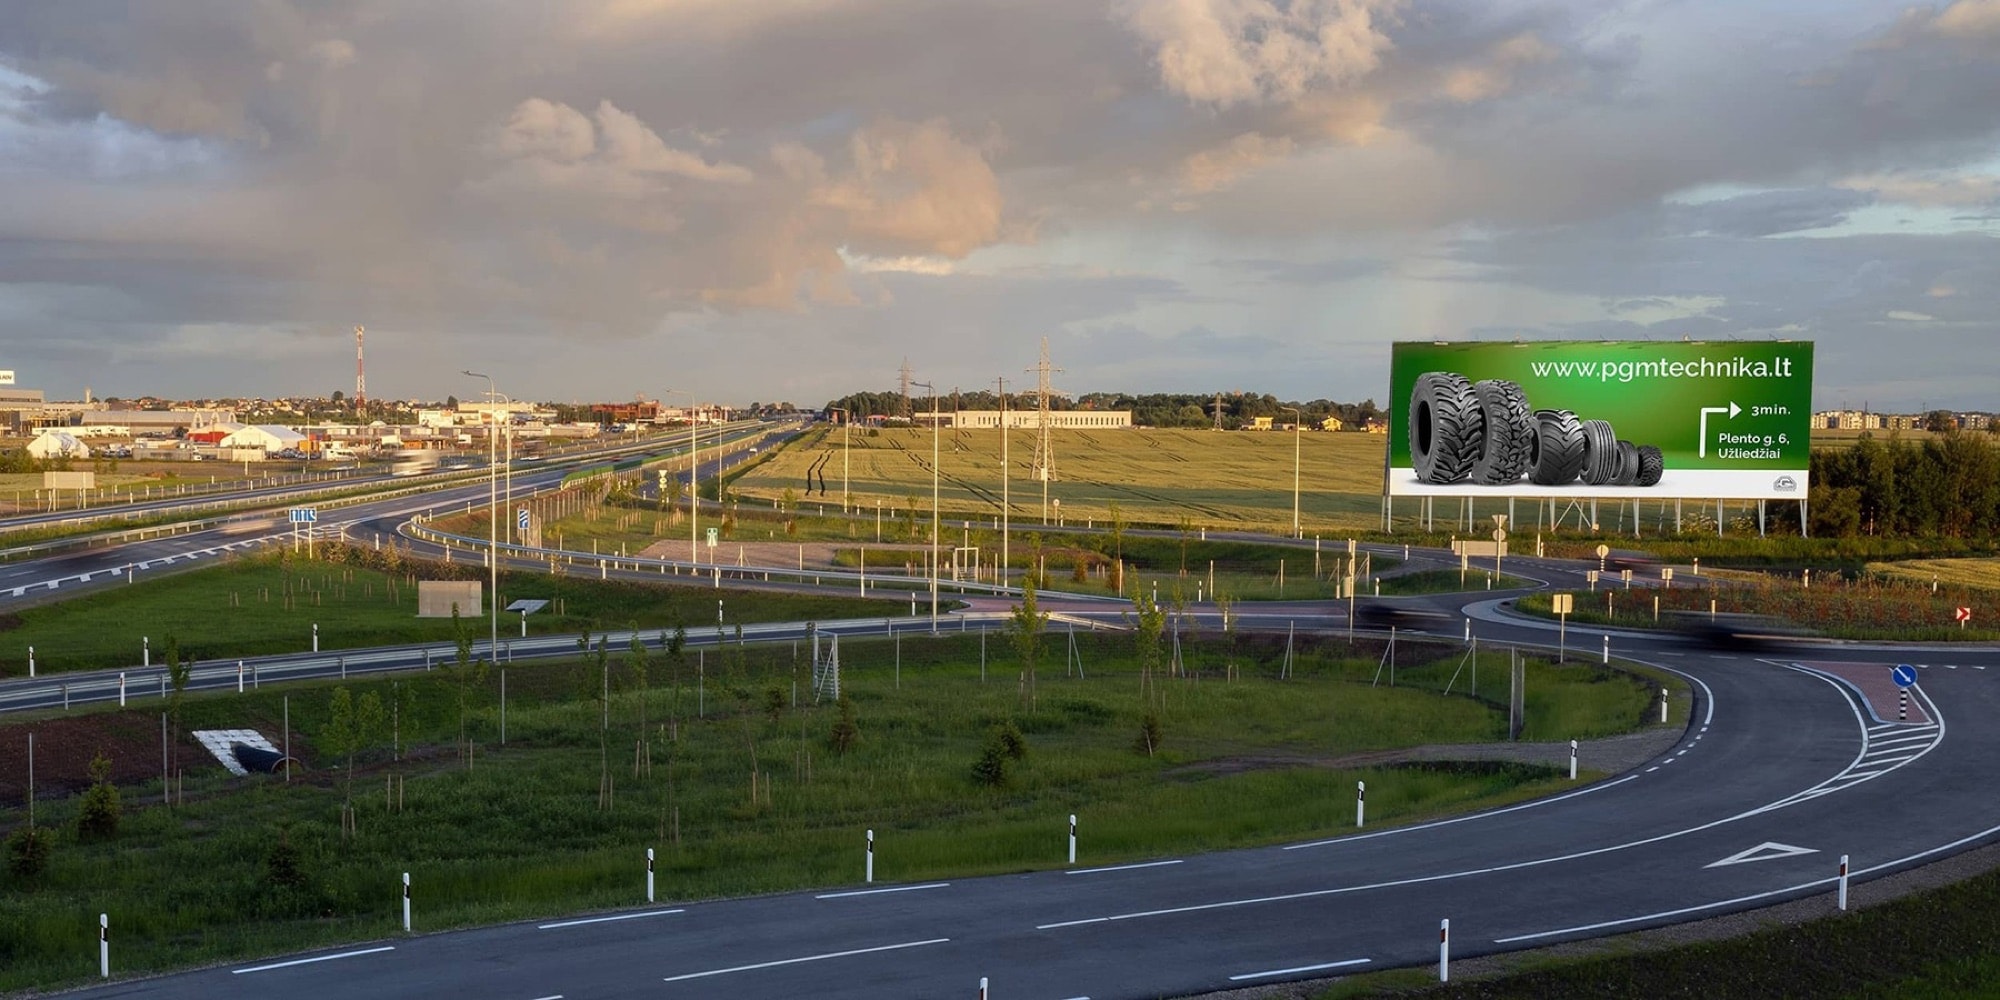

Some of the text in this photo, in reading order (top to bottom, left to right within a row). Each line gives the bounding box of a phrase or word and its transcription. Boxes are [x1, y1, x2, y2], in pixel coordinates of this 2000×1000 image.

[1530, 356, 1793, 383] www.pgmtechnika.lt
[1751, 404, 1791, 417] 3min.
[1718, 432, 1790, 447] Plento g. 6,
[1718, 447, 1781, 459] Užliedžiai
